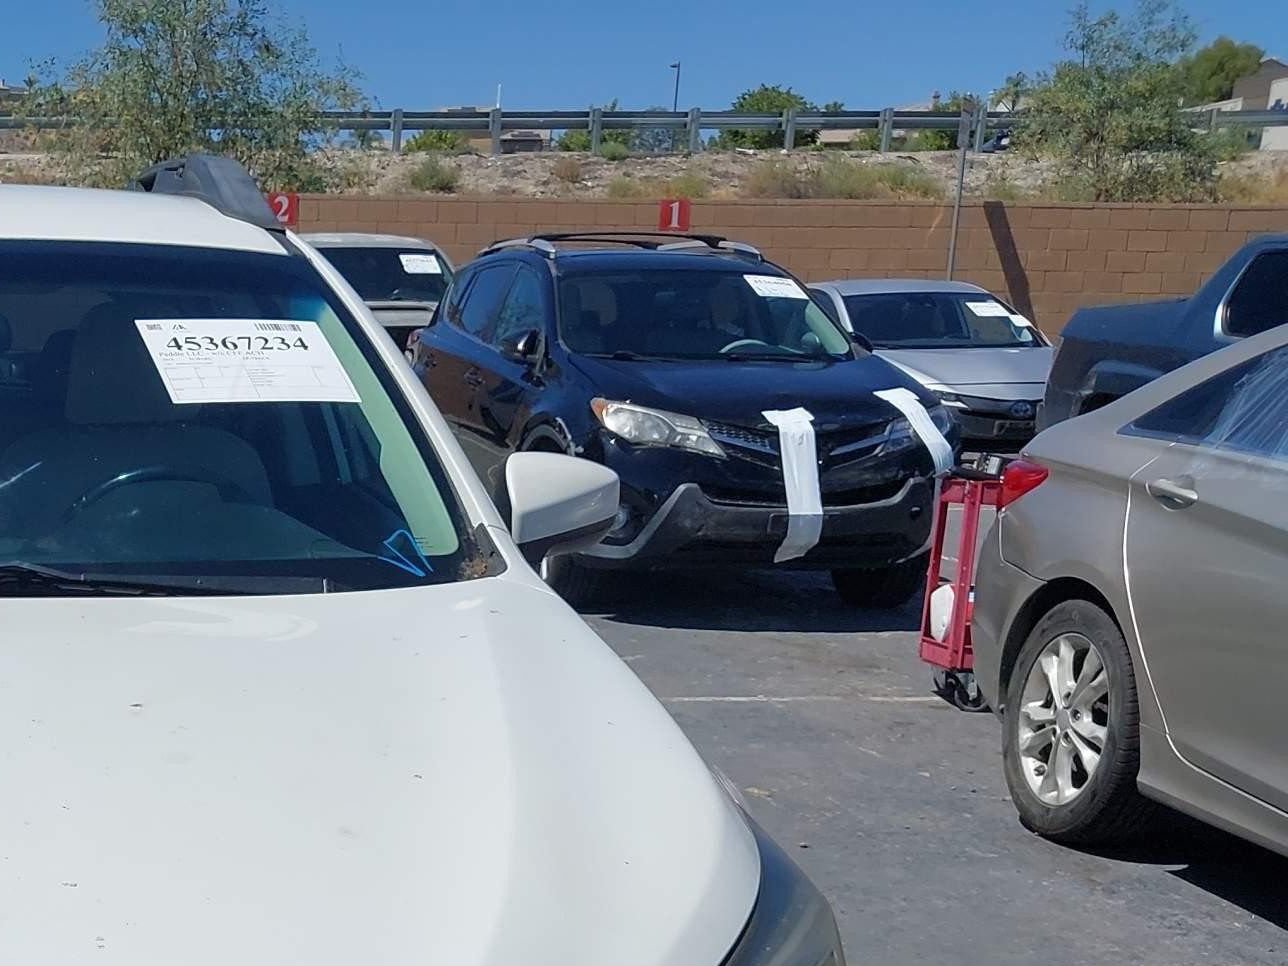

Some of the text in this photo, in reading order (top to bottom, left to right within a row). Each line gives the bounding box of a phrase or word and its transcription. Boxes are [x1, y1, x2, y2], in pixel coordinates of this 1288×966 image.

[273, 195, 289, 222] 2
[668, 201, 680, 228] 1
[166, 336, 308, 351] 45367234
